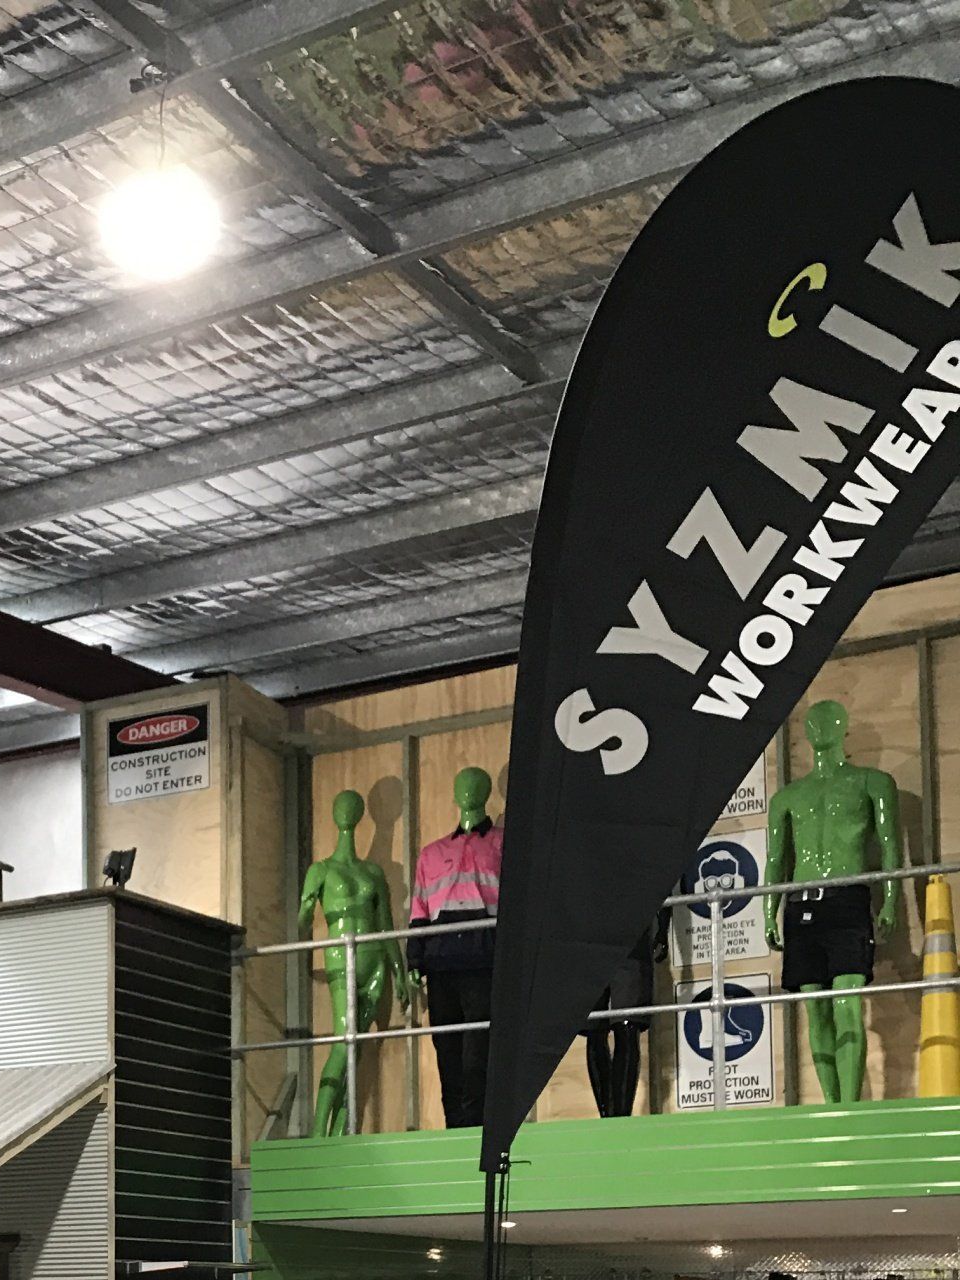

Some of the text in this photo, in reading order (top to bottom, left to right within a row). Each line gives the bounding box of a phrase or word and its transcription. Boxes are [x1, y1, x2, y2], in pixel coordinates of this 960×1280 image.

[555, 191, 960, 775] SYZMIK
[128, 719, 187, 741] DANGER
[111, 746, 206, 772] CONSTRUCTION
[145, 766, 171, 780] SITE
[115, 775, 202, 798] DO NOT ENTER
[727, 800, 763, 813] WORN
[689, 1076, 759, 1091] PROCTION
[734, 1088, 770, 1100] WORN
